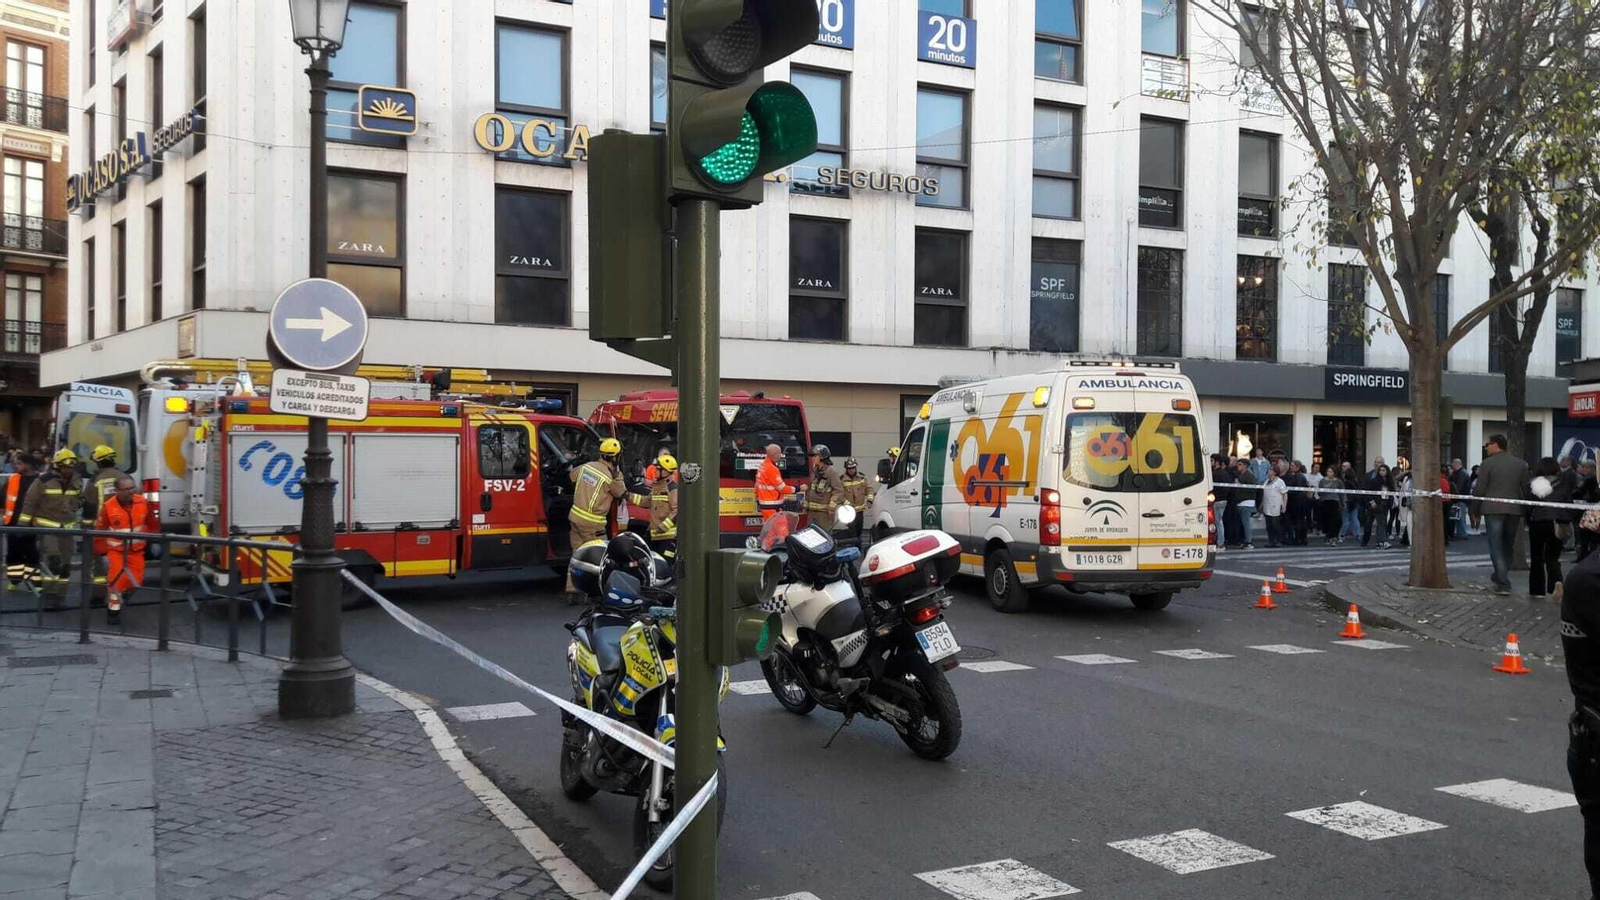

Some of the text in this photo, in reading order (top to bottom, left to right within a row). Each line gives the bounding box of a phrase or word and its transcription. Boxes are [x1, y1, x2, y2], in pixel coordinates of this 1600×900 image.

[818, 0, 844, 33] 0
[928, 15, 967, 53] 20
[928, 50, 966, 64] minutos
[79, 149, 120, 202] OCASO
[152, 111, 193, 154] SEGUROS
[817, 165, 940, 196] SEGUROS
[337, 241, 385, 253] ZARA
[509, 255, 552, 267] ZARA
[798, 278, 832, 288] ZARA
[1040, 277, 1066, 291] SPF
[921, 286, 954, 296] ZARA
[1031, 290, 1075, 300] SPRINGFIELD
[1558, 318, 1574, 329] SPF
[286, 377, 356, 392] EXCEPTO BUS, TAXIS
[1078, 380, 1184, 390] AMBULANCIA
[1333, 373, 1405, 389] SPRINGFIELD
[316, 393, 364, 404] ACREDITADOS
[281, 401, 287, 409] Y
[288, 402, 312, 411] CARGA
[319, 405, 356, 416] DESCARGA
[953, 392, 1044, 496] 061
[1086, 412, 1196, 476] 061
[1086, 432, 1133, 458] 061
[484, 479, 526, 492] FSV-2
[963, 453, 1010, 508] 061
[1020, 519, 1038, 530] E-178
[1083, 554, 1124, 565] 1018 GZR
[1174, 548, 1204, 559] E-178
[924, 624, 949, 642] 6594
[632, 664, 654, 682] LOCAL
